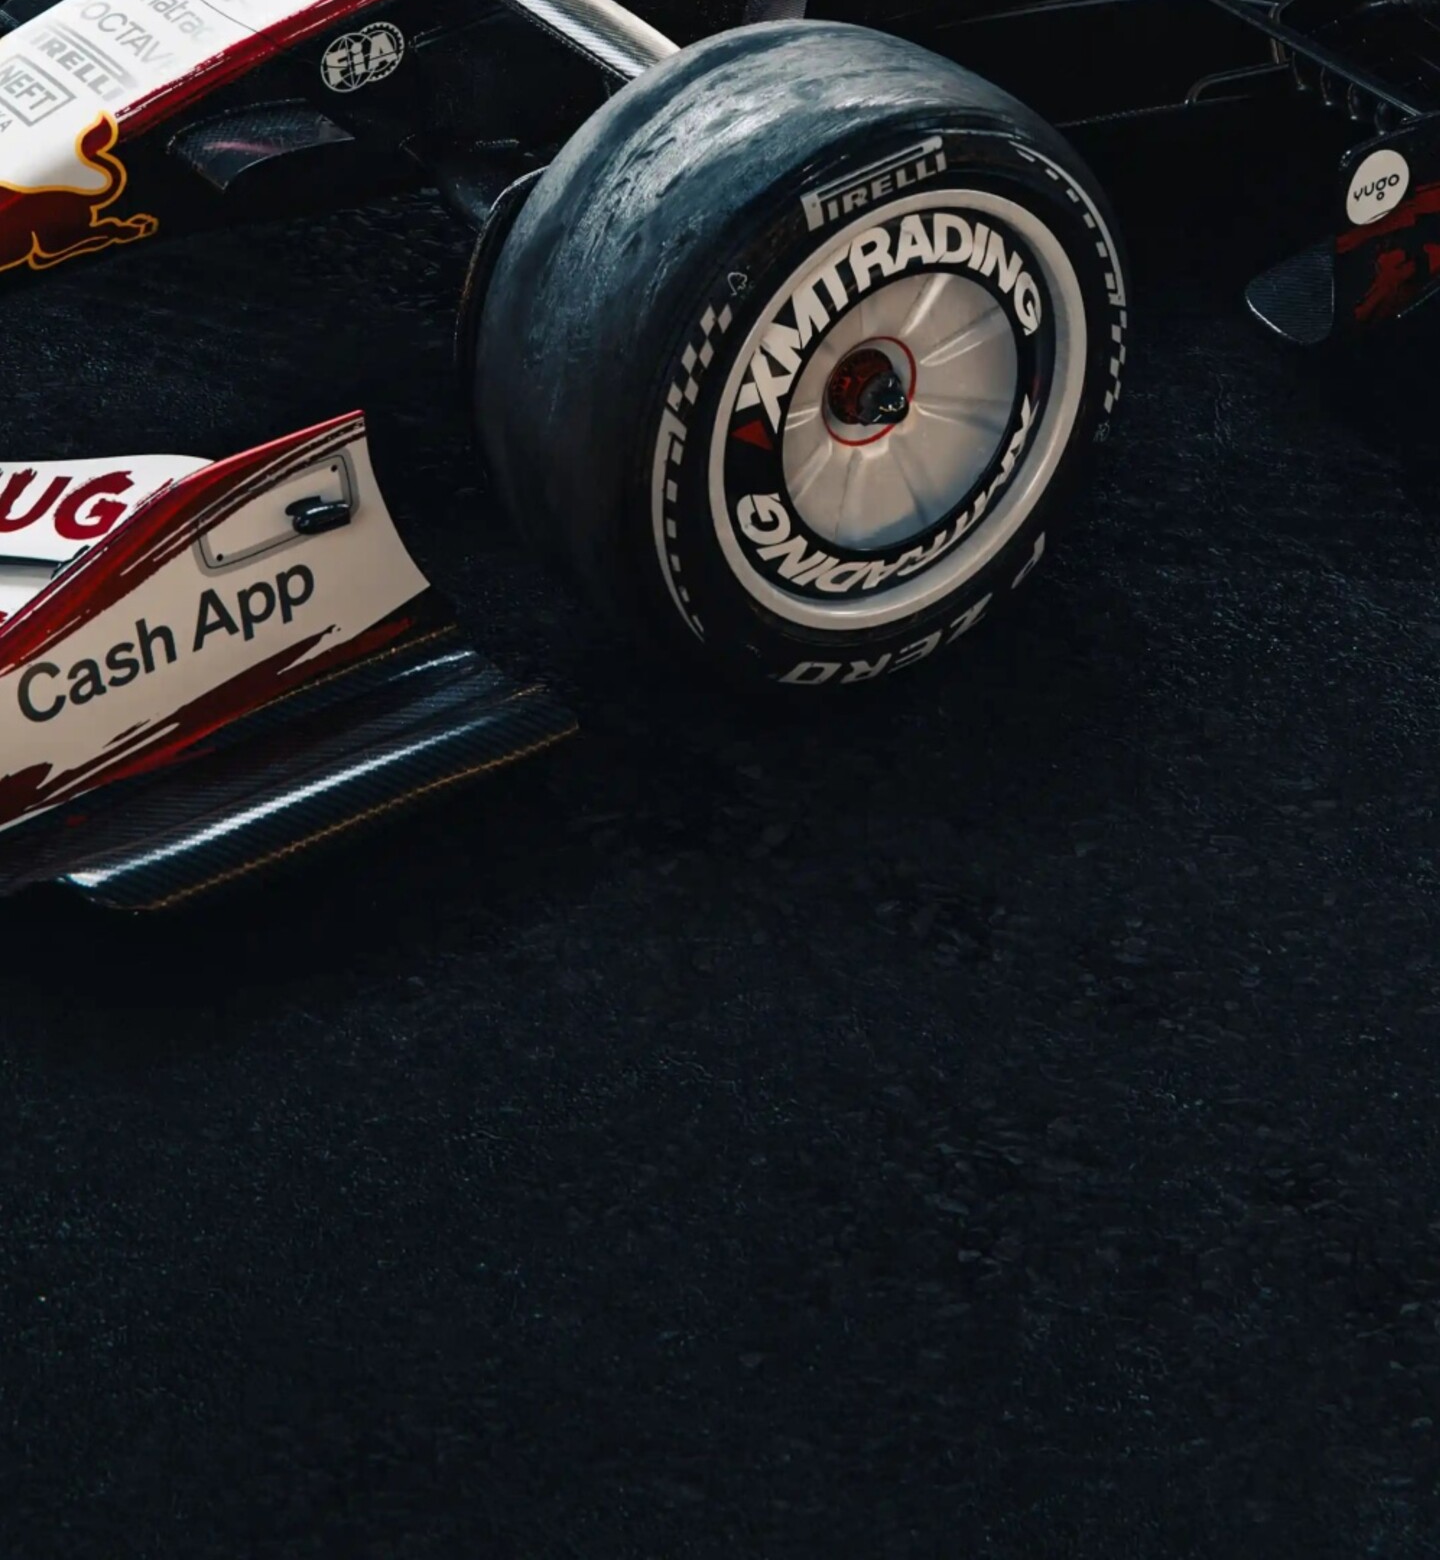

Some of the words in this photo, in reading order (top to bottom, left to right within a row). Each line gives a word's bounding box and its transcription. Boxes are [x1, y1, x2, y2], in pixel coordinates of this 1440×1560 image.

[79, 1, 175, 65] OCTAV
[800, 135, 949, 232] PIRELLI
[735, 212, 1043, 435] XMTRADING
[0, 467, 135, 541] UG
[17, 618, 178, 723] Cash
[192, 563, 315, 652] App
[778, 592, 993, 686] ZERO
